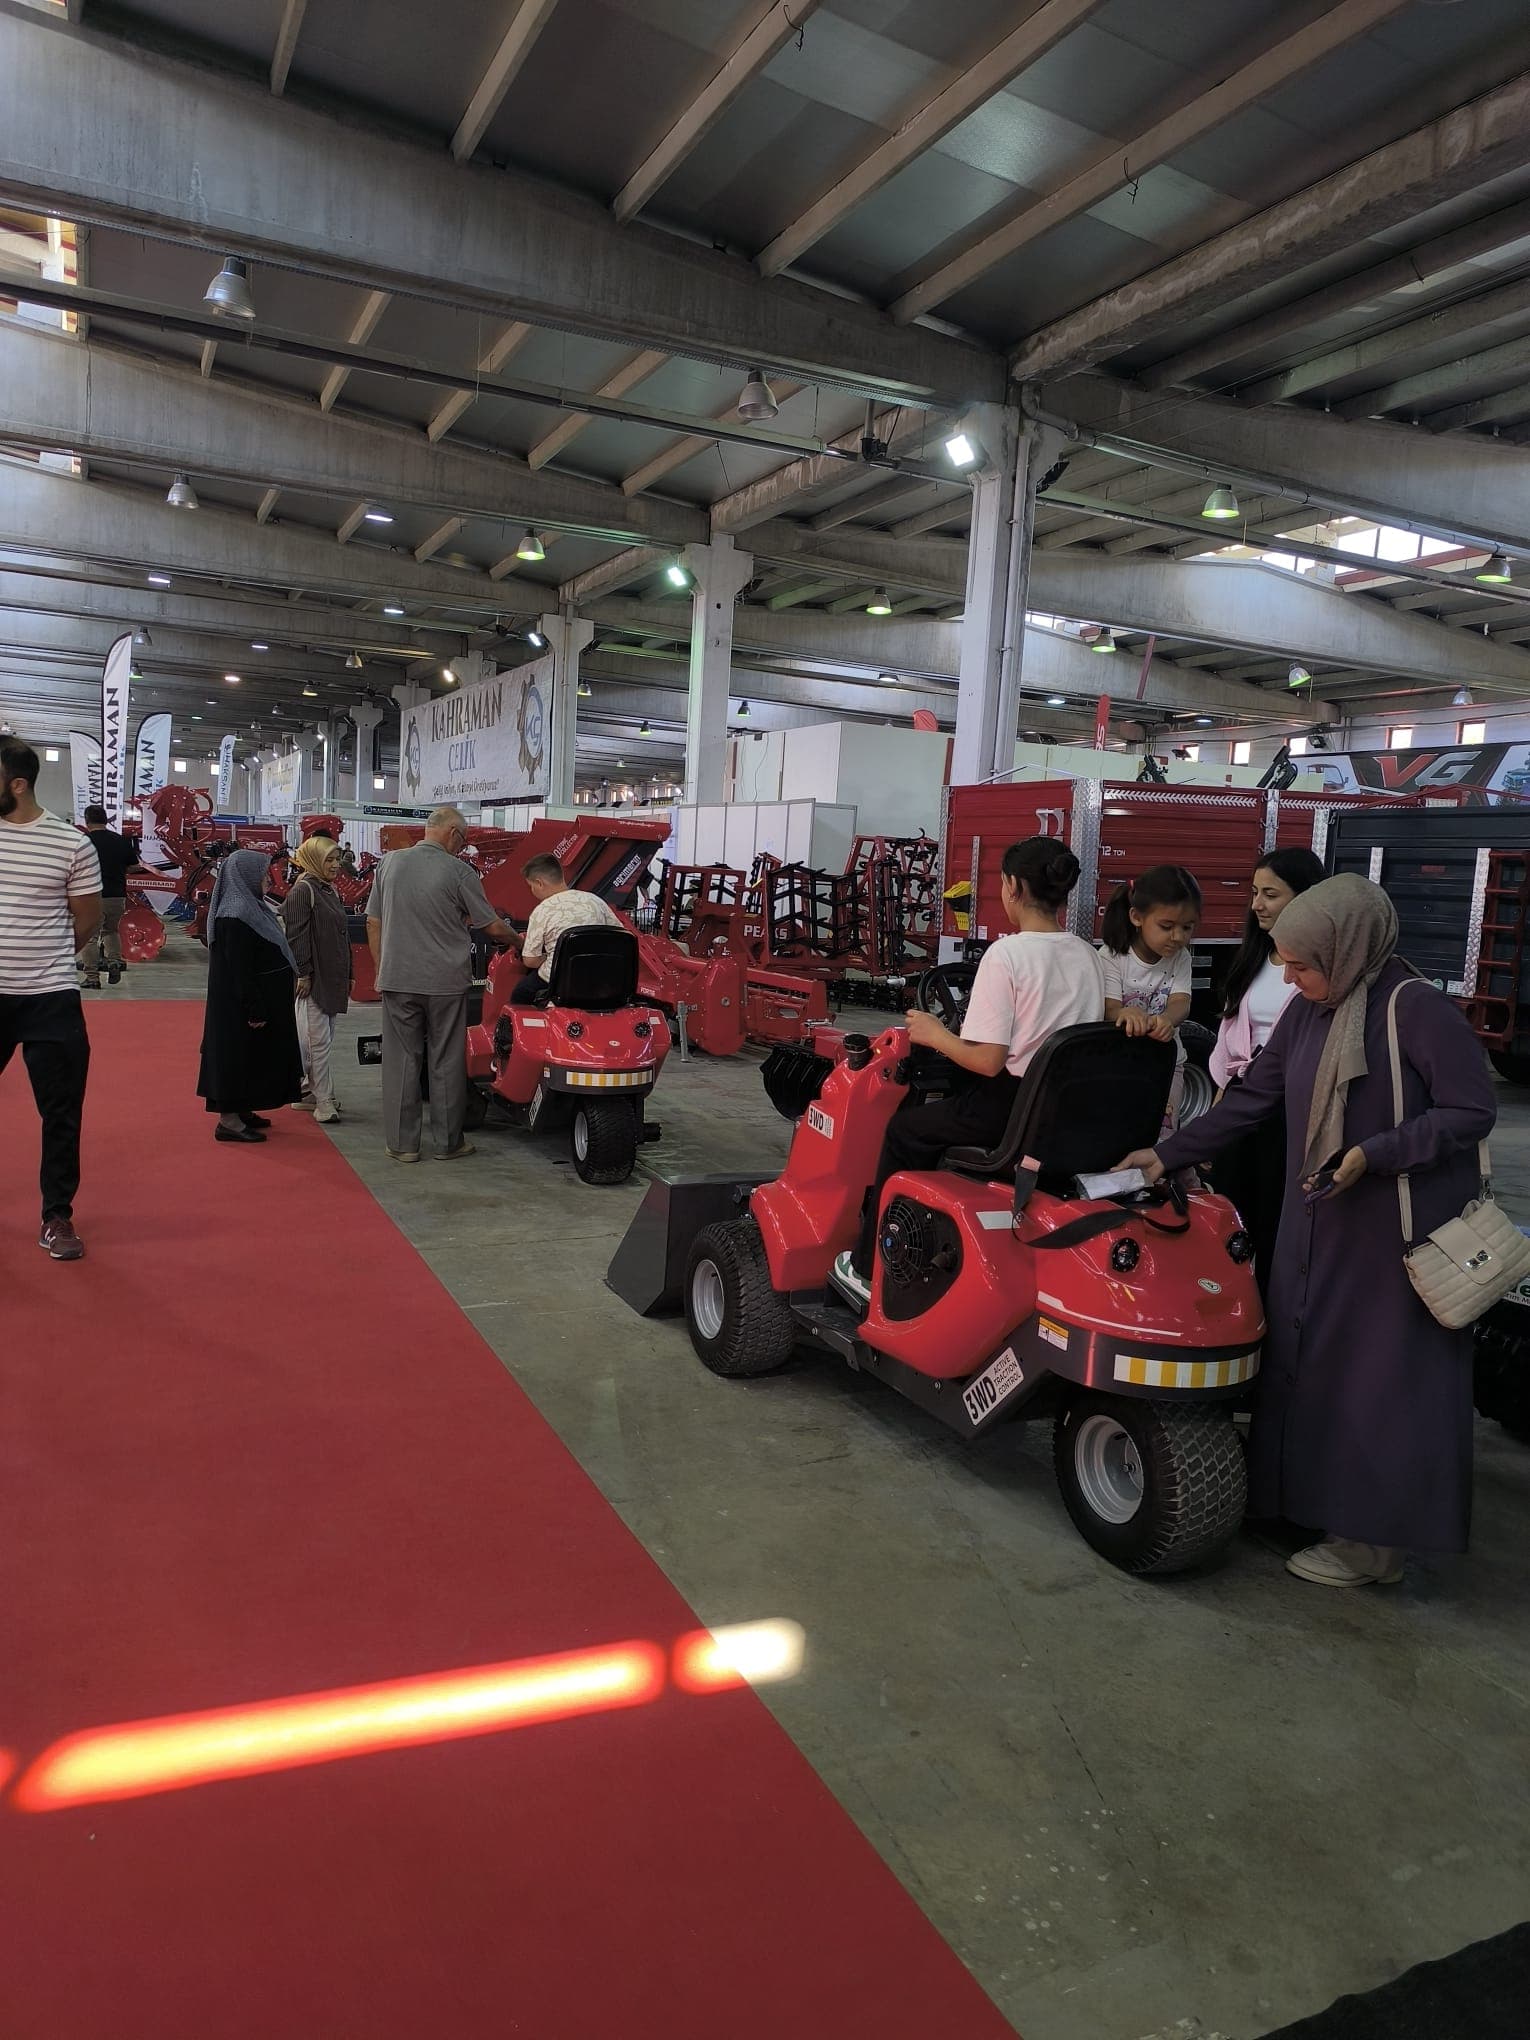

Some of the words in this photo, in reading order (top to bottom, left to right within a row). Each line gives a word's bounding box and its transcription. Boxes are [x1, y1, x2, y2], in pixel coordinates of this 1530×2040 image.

[432, 683, 502, 742] KAHRAMAN
[106, 688, 119, 830] AHRAMAN
[139, 740, 155, 794] AMAN
[448, 734, 476, 776] ÇELİK
[1373, 751, 1482, 788] VG
[1102, 846, 1112, 856] 12
[810, 1107, 824, 1130] 3WD
[994, 1355, 1011, 1375] ACTIVE
[994, 1361, 1018, 1386] TRACTION
[965, 1376, 997, 1420] 3WD
[999, 1373, 1021, 1395] CONTROL
